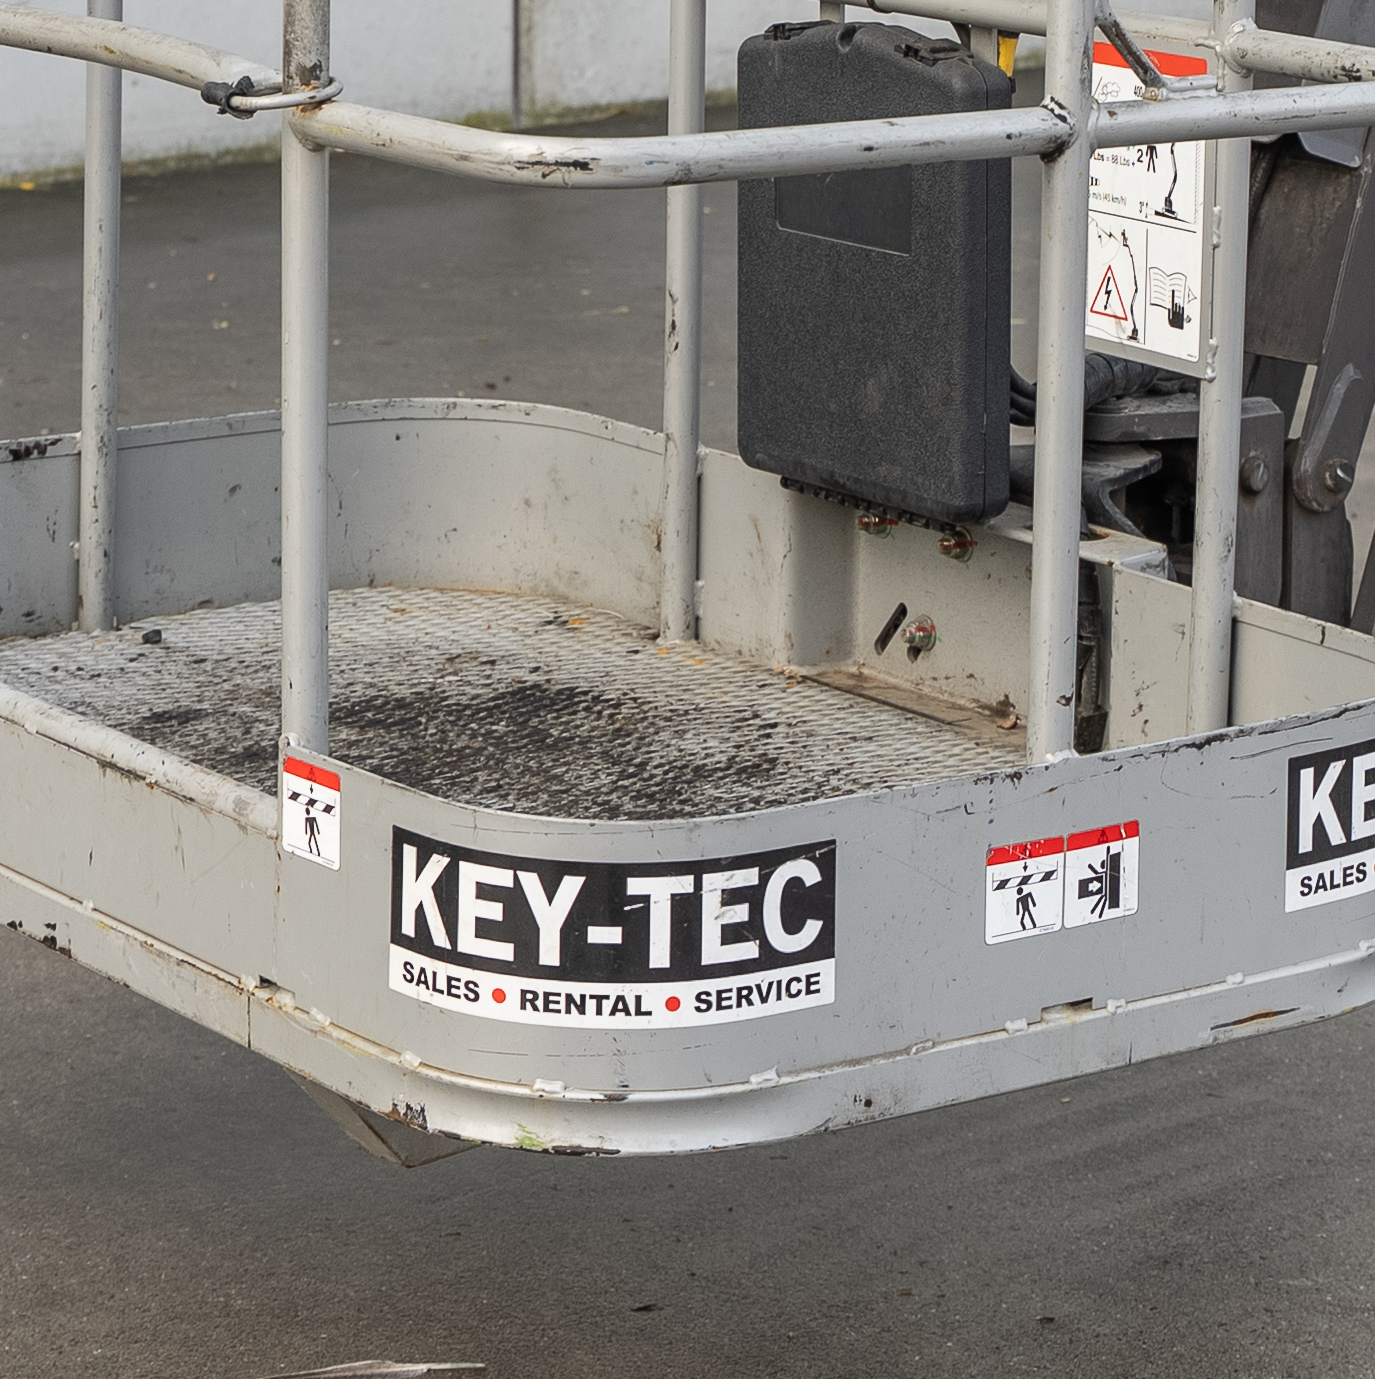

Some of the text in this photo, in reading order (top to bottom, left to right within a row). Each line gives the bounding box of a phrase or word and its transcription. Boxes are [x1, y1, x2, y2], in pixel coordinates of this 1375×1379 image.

[1136, 148, 1144, 163] 2
[1299, 861, 1368, 897] SALES
[400, 843, 824, 969] KEY-TEC
[401, 959, 822, 1018] SALES RENTAL SERVICE
